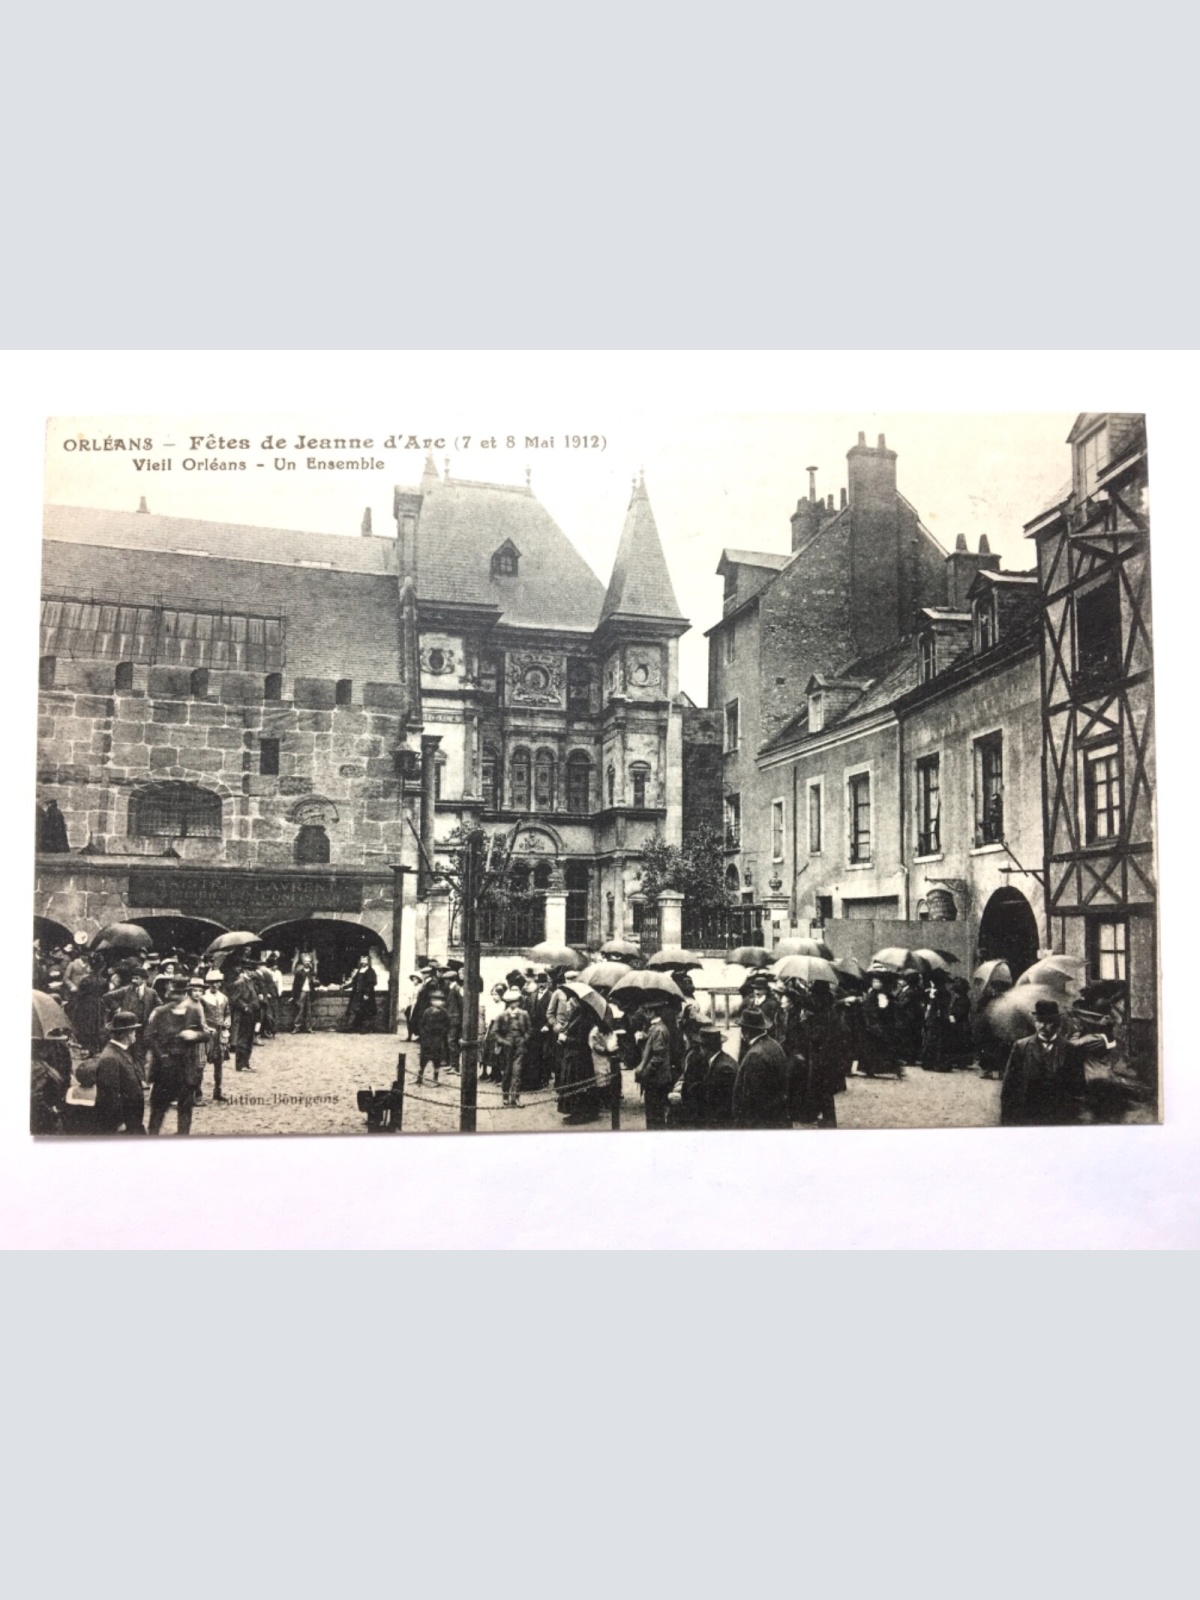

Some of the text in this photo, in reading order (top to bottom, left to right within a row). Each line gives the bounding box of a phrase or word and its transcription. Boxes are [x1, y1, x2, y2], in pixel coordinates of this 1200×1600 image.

[63, 435, 153, 451] ORLÉANS
[189, 434, 250, 450] Fêtes
[260, 435, 287, 450] de
[294, 435, 374, 450] Jeanne
[454, 435, 471, 451] (7
[480, 437, 497, 449] et
[506, 435, 516, 449] 8
[525, 436, 555, 449] Mai
[564, 435, 607, 451] 1912)
[132, 458, 172, 472] Vieil
[182, 458, 247, 472] Orléans
[274, 458, 296, 471] Un
[306, 457, 385, 470] Ensemble
